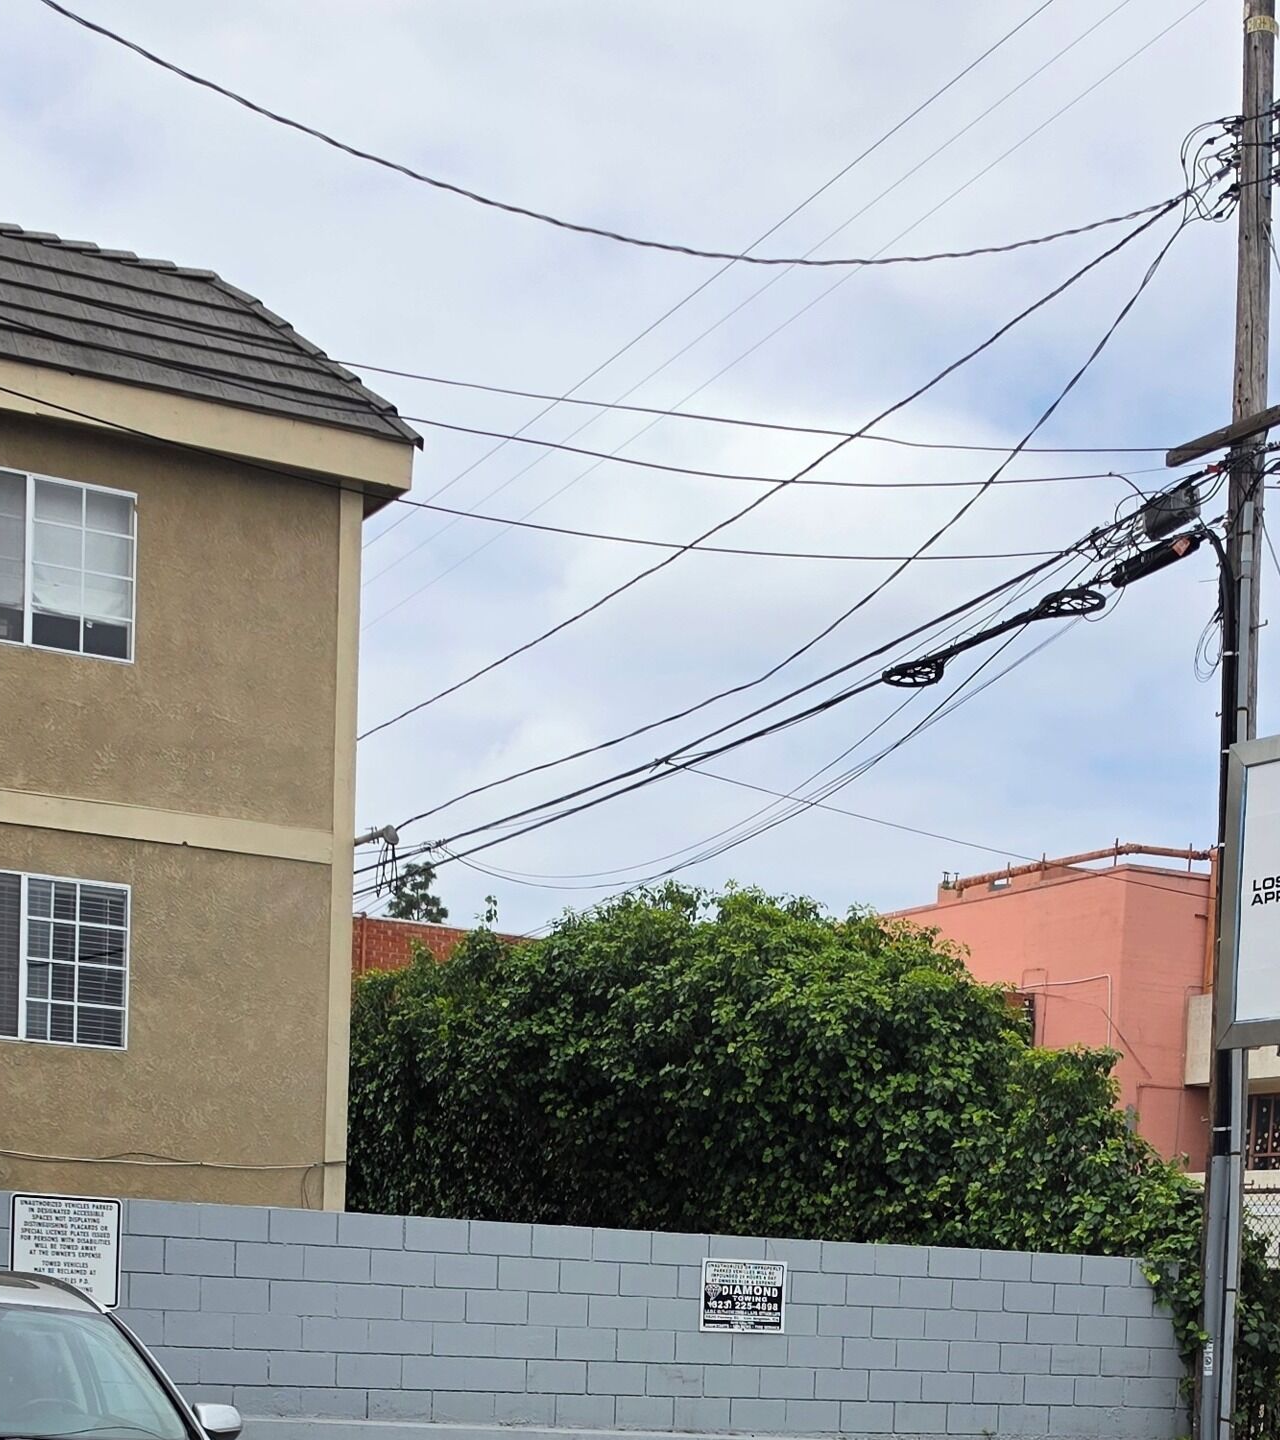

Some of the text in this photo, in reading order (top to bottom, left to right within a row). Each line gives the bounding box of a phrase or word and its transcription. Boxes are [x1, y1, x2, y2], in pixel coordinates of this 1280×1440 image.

[20, 1200, 62, 1208] UNAUTHORIZED
[92, 1203, 114, 1211] PARKED
[37, 1207, 71, 1215] DESIGNATED
[73, 1209, 104, 1217] ACCESSIBLE
[68, 1216, 101, 1224] DISPLAYING
[20, 1227, 43, 1235] SPECIAL
[70, 1223, 98, 1231] PLACARDS
[57, 1268, 87, 1276] RECLAIMED
[722, 1285, 778, 1297] DIAMOND
